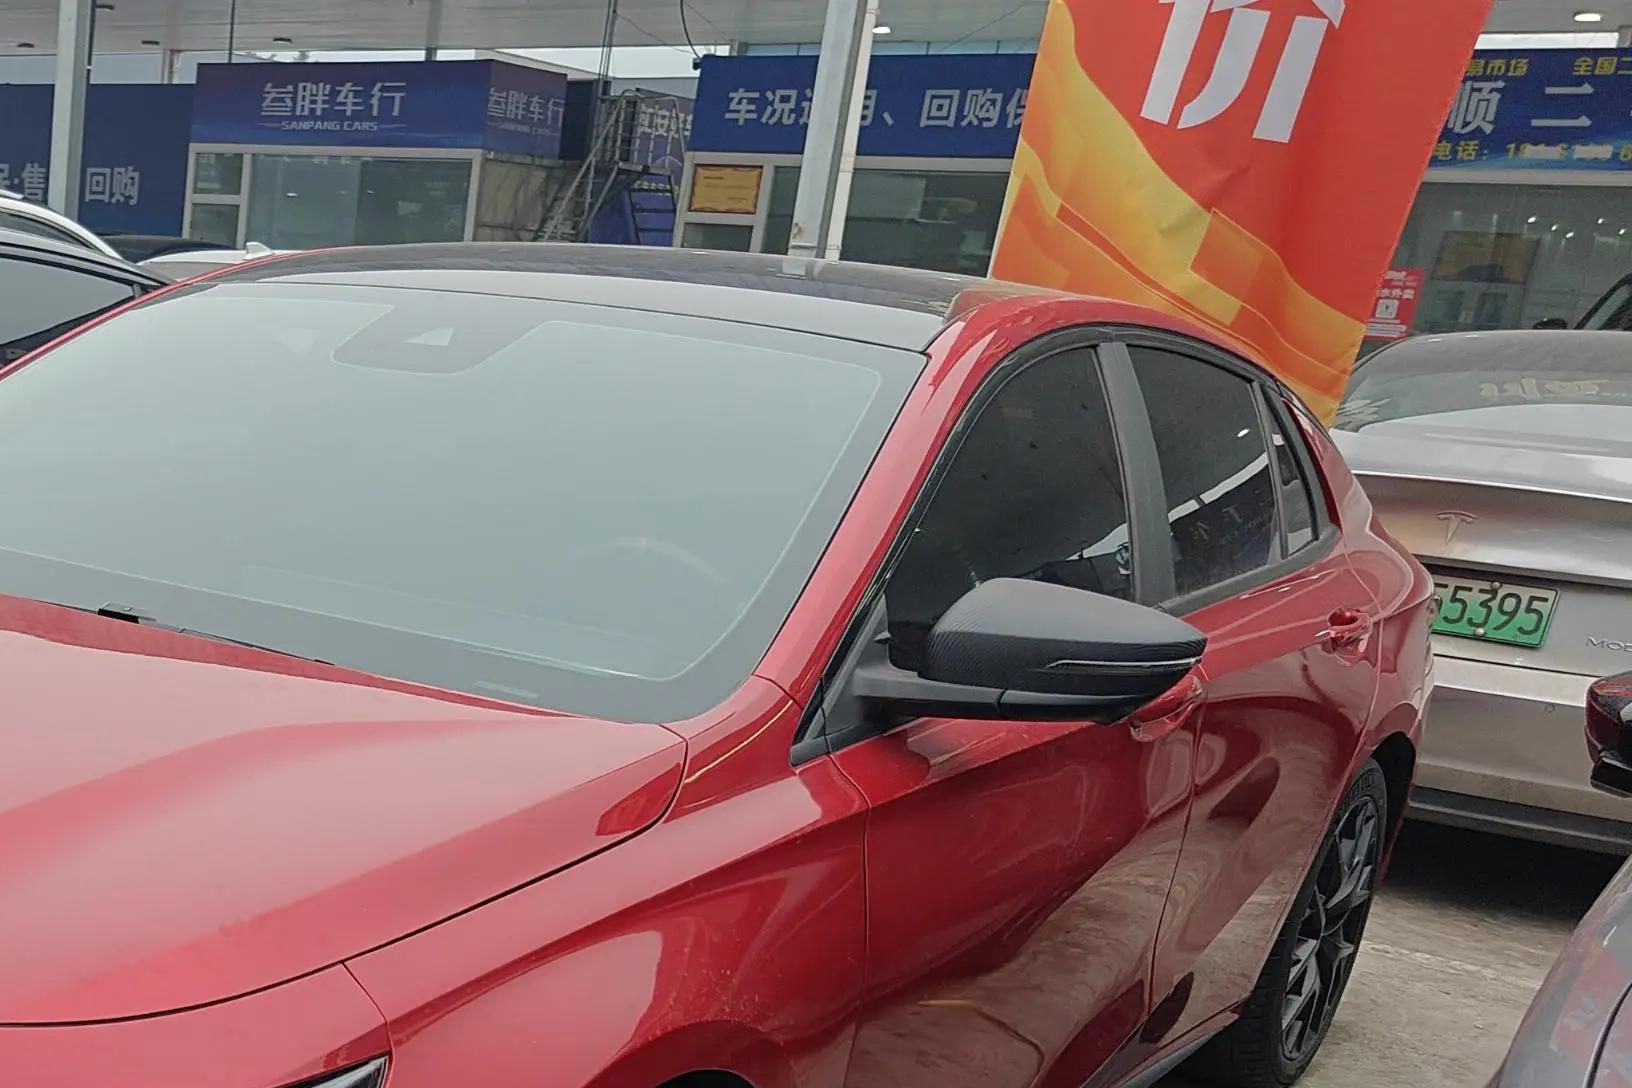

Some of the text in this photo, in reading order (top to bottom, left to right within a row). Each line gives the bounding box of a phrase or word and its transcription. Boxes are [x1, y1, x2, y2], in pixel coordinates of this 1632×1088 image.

[281, 121, 378, 131] SANPANG CARS
[85, 167, 139, 206] 回购
